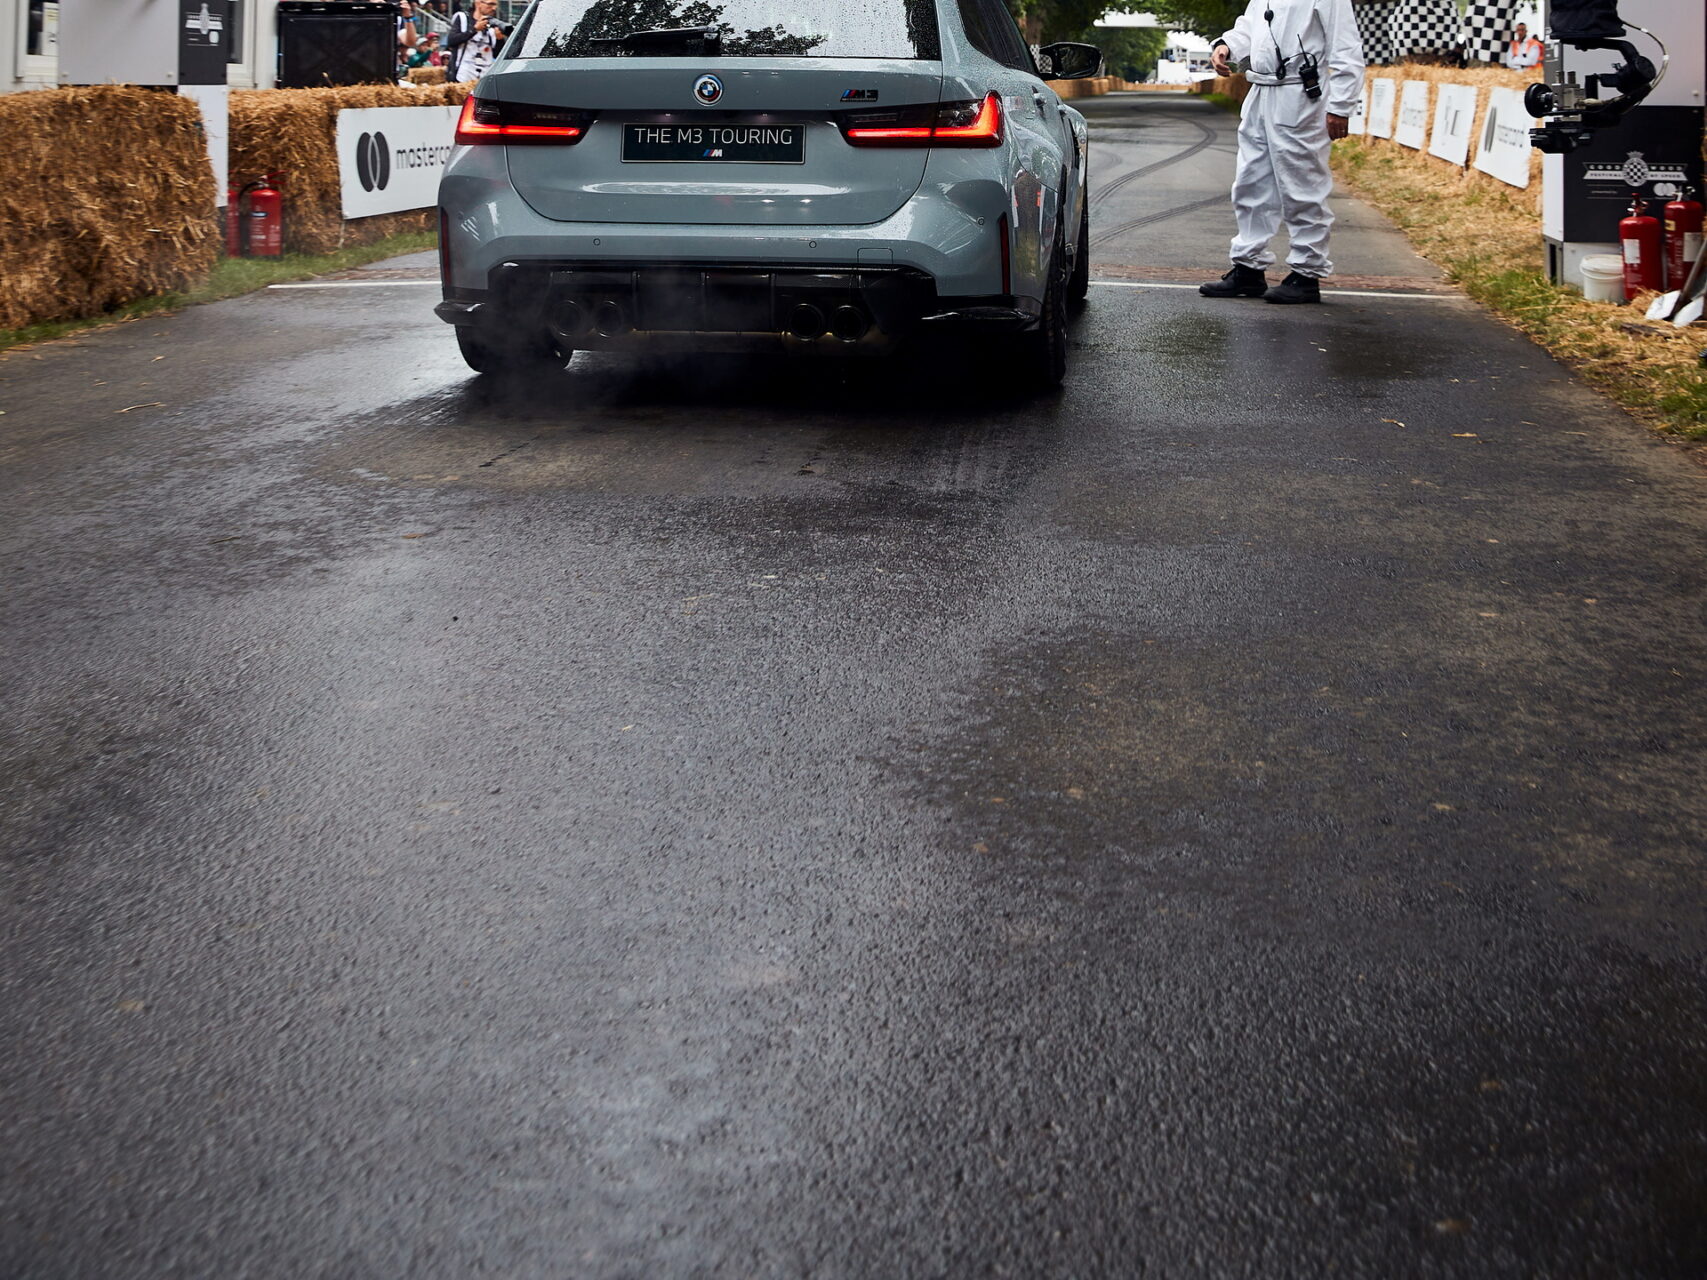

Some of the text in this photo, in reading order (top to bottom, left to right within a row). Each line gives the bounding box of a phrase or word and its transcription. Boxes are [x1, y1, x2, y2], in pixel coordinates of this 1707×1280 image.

[634, 127, 793, 145] THE M3 TOURING
